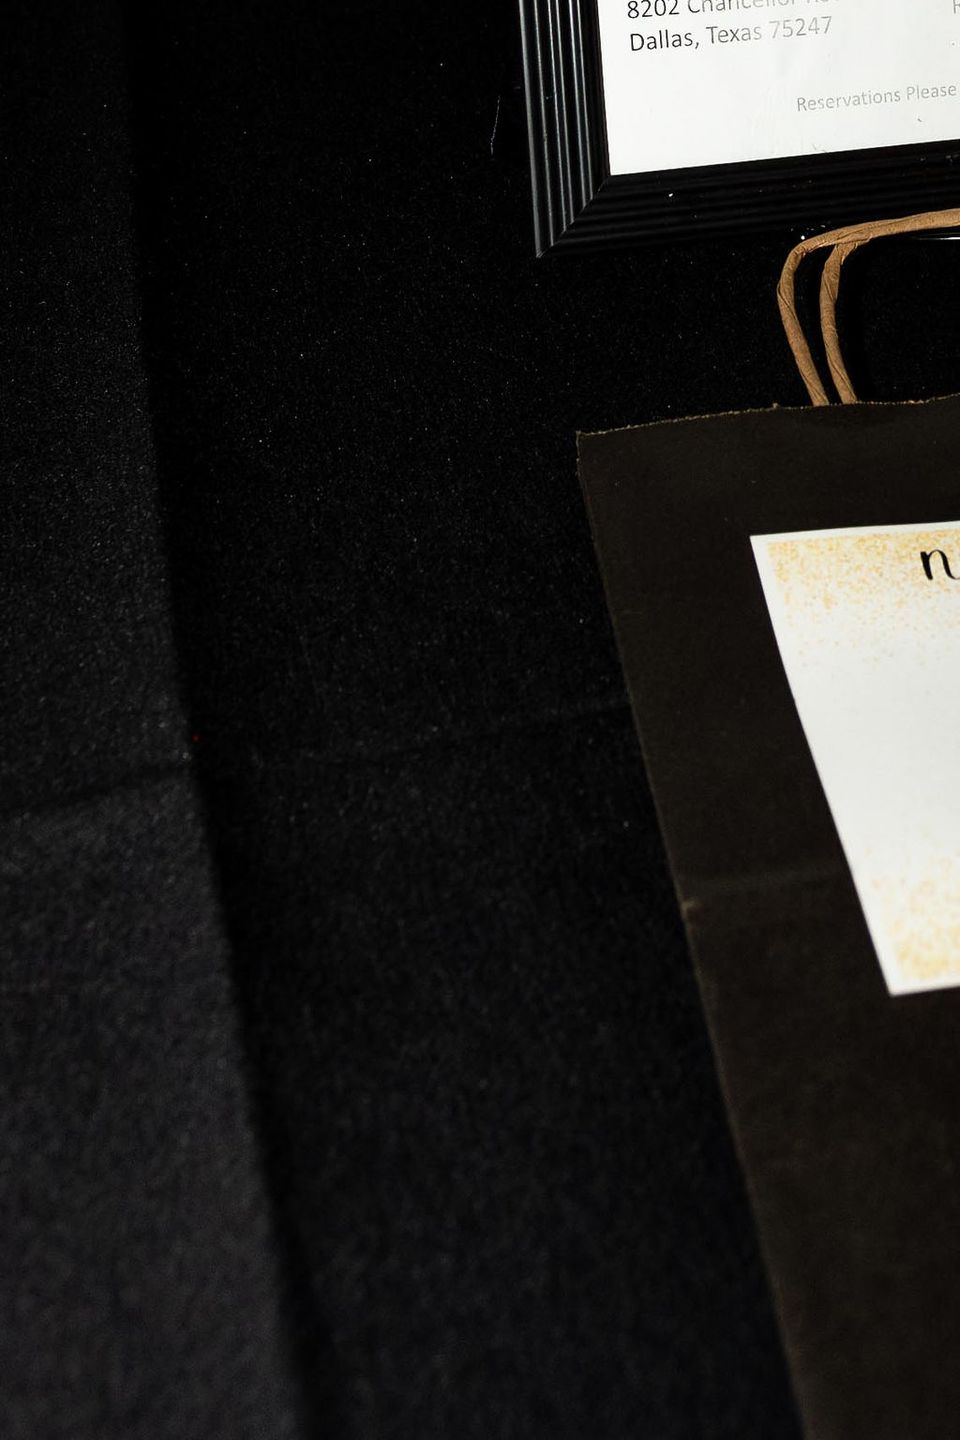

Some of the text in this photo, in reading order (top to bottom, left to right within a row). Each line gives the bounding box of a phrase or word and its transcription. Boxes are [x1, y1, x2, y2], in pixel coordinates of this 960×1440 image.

[629, 15, 833, 52] Dallas, Texas 75247
[796, 87, 901, 112] Reservations
[906, 82, 958, 102] Please
